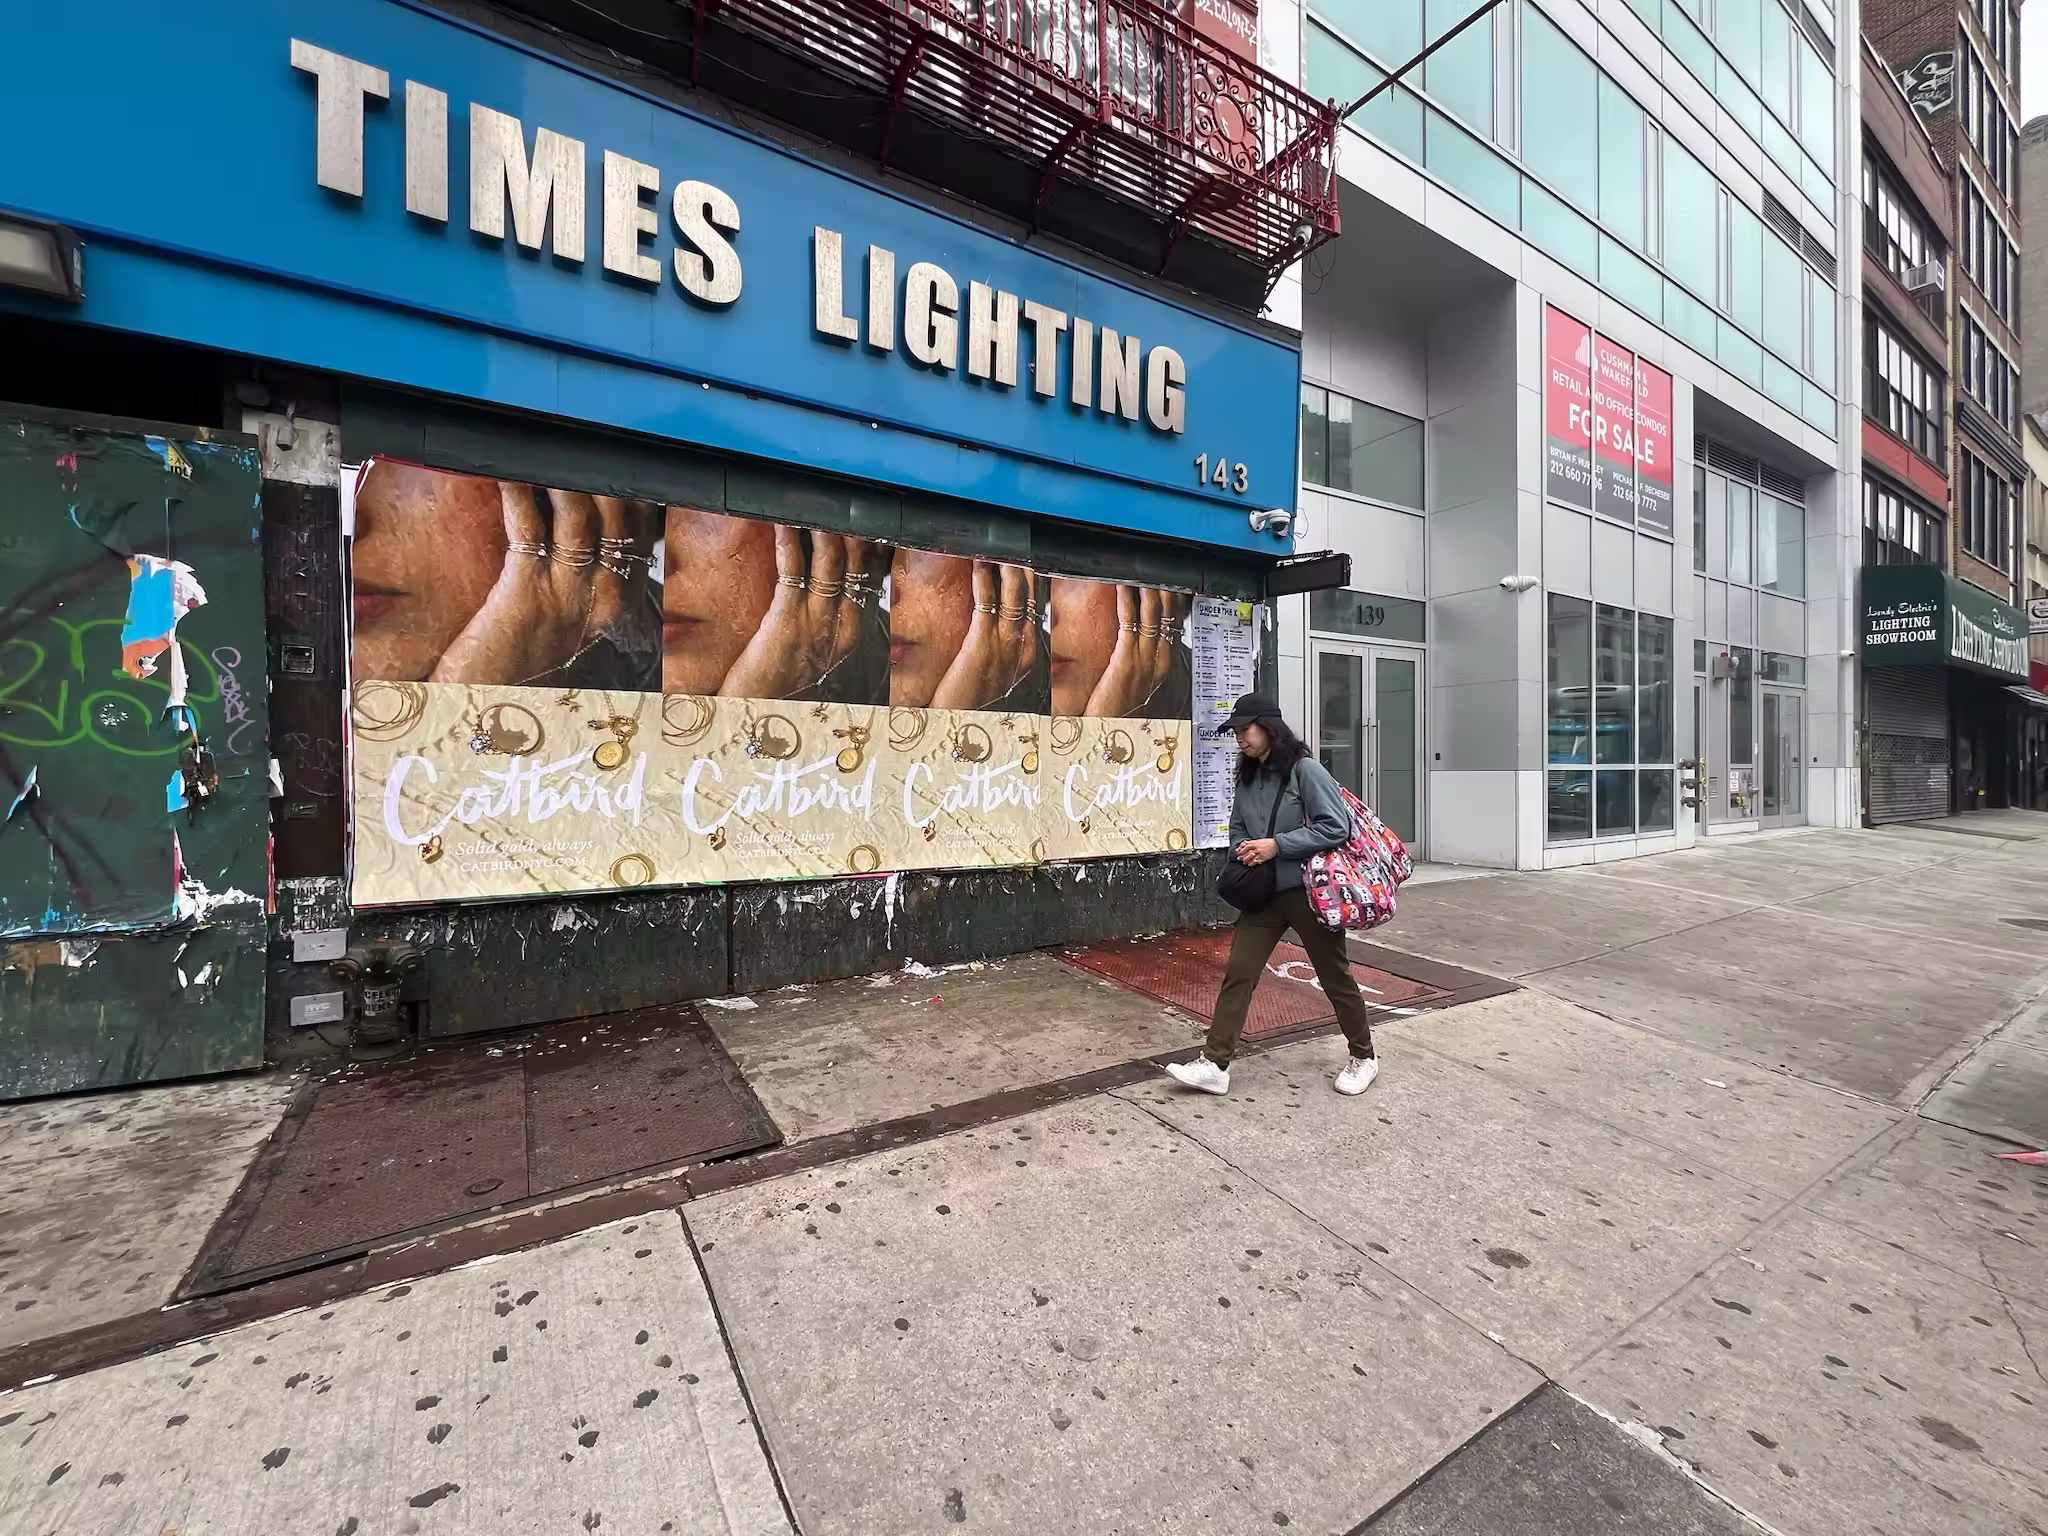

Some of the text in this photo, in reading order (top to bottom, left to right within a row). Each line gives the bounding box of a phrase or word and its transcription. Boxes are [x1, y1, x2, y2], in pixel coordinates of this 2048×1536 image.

[289, 37, 1187, 434] TIMES LIGHTING
[1600, 348, 1648, 385] CUSHMAN &
[1600, 363, 1649, 398] WAKEFILD
[1552, 369, 1667, 436] RETAIL AND OFFICE CONDOS
[1569, 402, 1655, 465] FOR SALE
[1550, 446, 1571, 462] BRYAN
[1193, 452, 1250, 495] 143
[1550, 460, 1564, 477] 212
[1565, 465, 1581, 483] 660
[1612, 471, 1639, 490] MICHAE
[1612, 484, 1624, 499] 212
[1641, 495, 1657, 512] 7772
[1199, 604, 1221, 614] UNDER
[1355, 604, 1385, 626] 139
[1871, 615, 1931, 631] LIGHTING
[1866, 629, 1937, 645] SHOWROOM
[1951, 604, 1993, 667] LIGHTING
[383, 746, 648, 846] Catbird
[682, 754, 878, 836] Catbird
[1063, 759, 1182, 823] Catbird
[455, 838, 593, 858] Solid gold, always
[735, 832, 765, 844] Solid
[798, 830, 836, 845] always
[459, 857, 587, 873] CATBIRDNYC.COM
